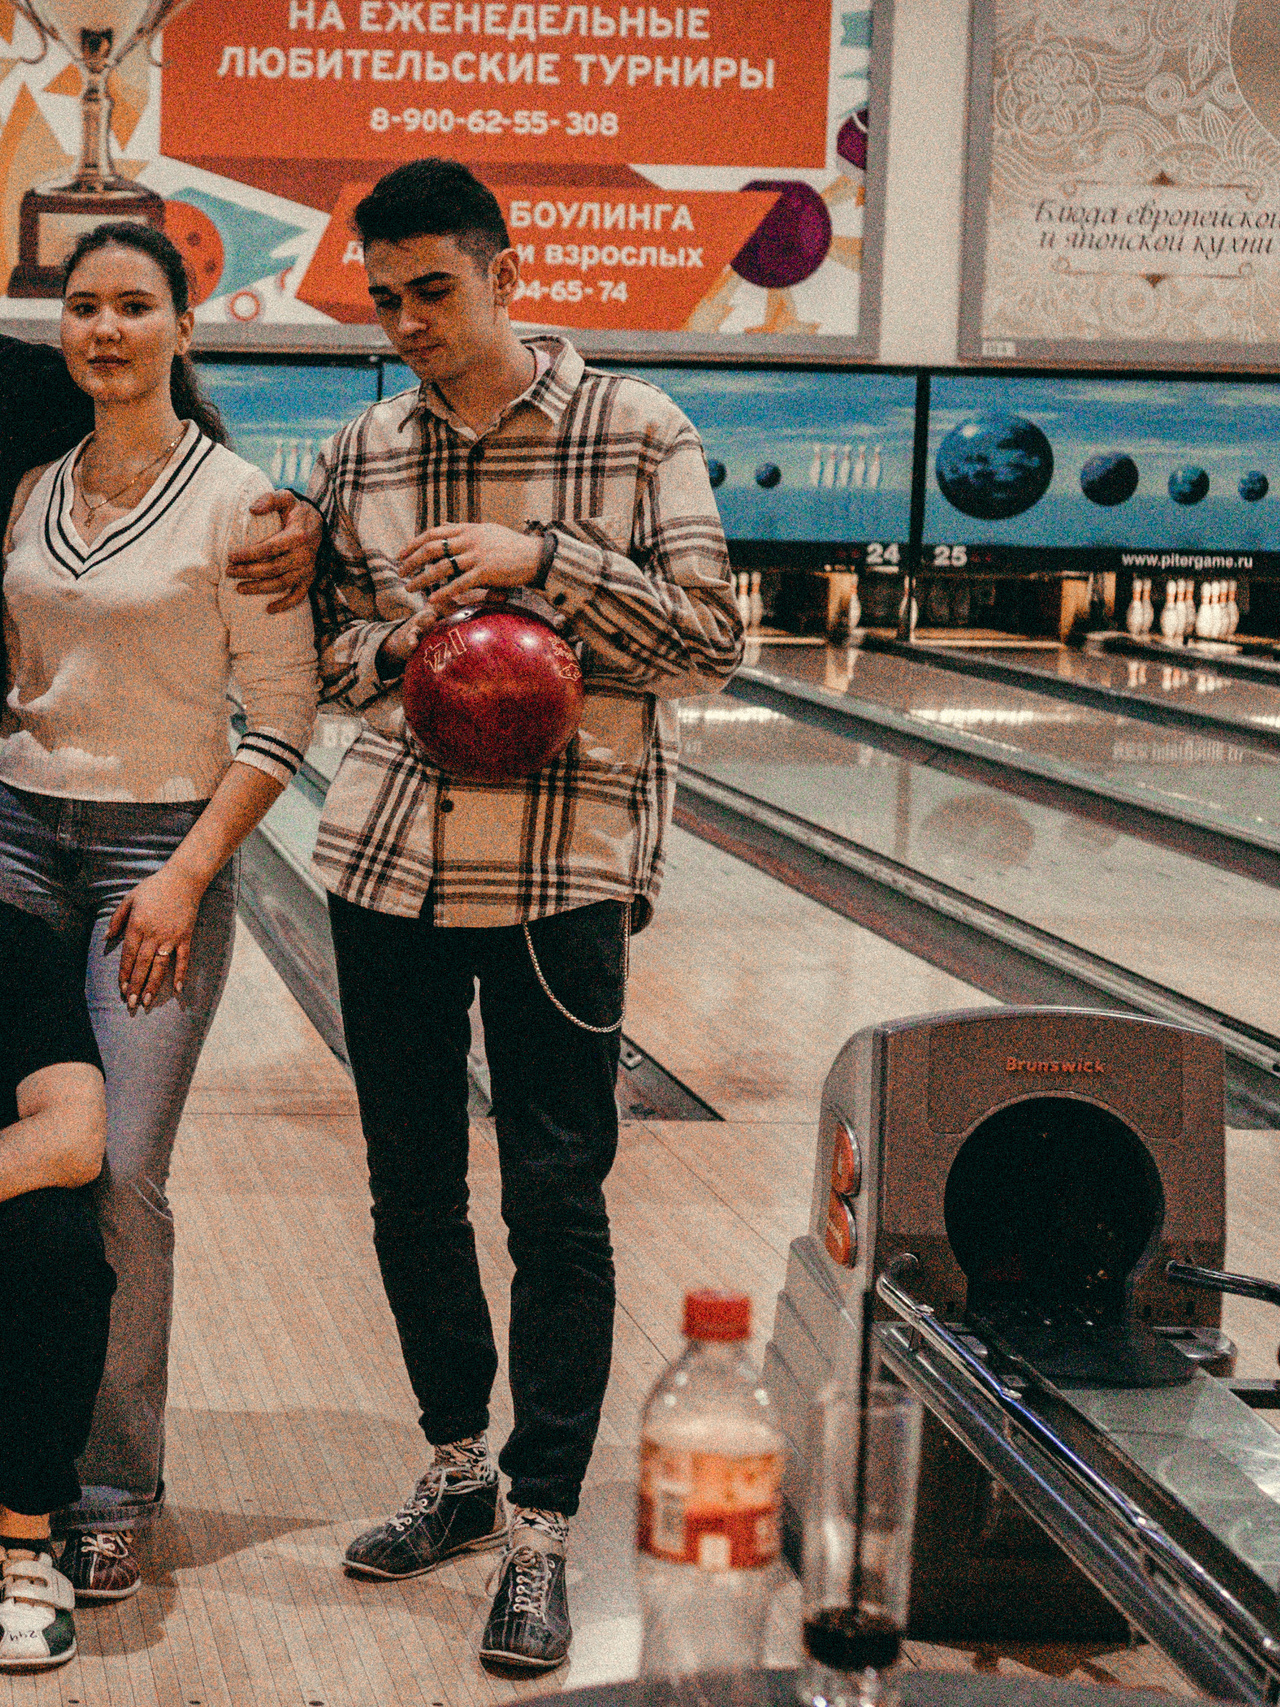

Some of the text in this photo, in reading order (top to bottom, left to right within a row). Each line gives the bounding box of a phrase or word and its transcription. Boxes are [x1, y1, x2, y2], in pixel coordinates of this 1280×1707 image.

[288, 1, 711, 42] НА ЕЖЕНЕДЕЛЬНЫЕ
[217, 46, 775, 90] ЛЮБИТЕЛЬСКИЕ ТУРНИРЫ
[510, 200, 694, 232] БОУЛИНГА
[545, 244, 704, 271] взрослых
[866, 543, 900, 564] 24
[933, 545, 967, 567] 25
[1122, 552, 1253, 570] www.pitergame.ru
[1006, 1057, 1104, 1073] Brunswick
